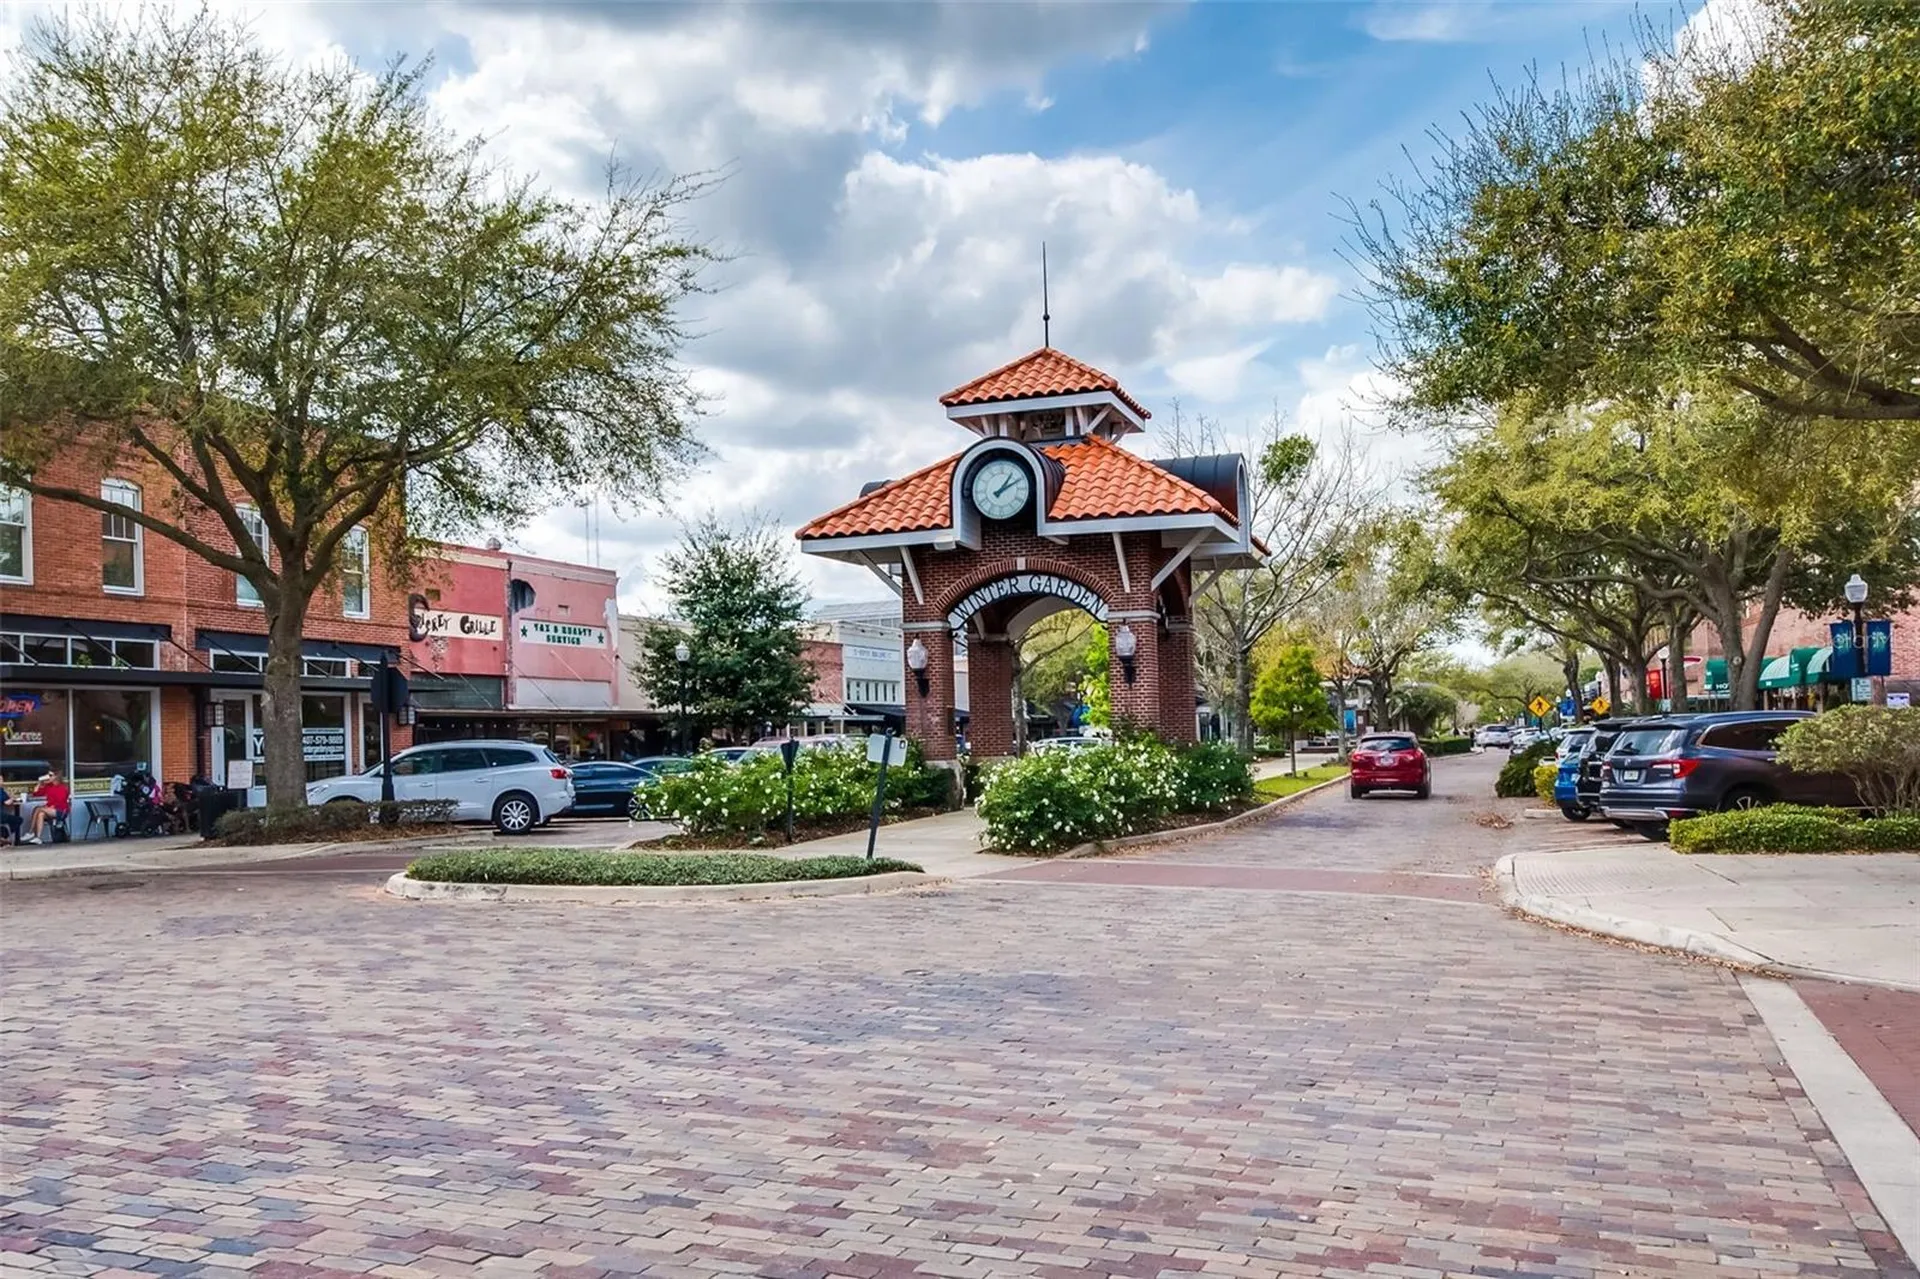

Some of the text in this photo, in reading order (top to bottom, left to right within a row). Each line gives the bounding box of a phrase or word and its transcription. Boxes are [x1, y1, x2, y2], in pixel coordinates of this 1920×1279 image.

[955, 574, 1105, 620] WINTER GARDEN
[460, 615, 496, 635] GRILLE
[534, 623, 550, 632] TAX
[0, 700, 35, 713] OPEN
